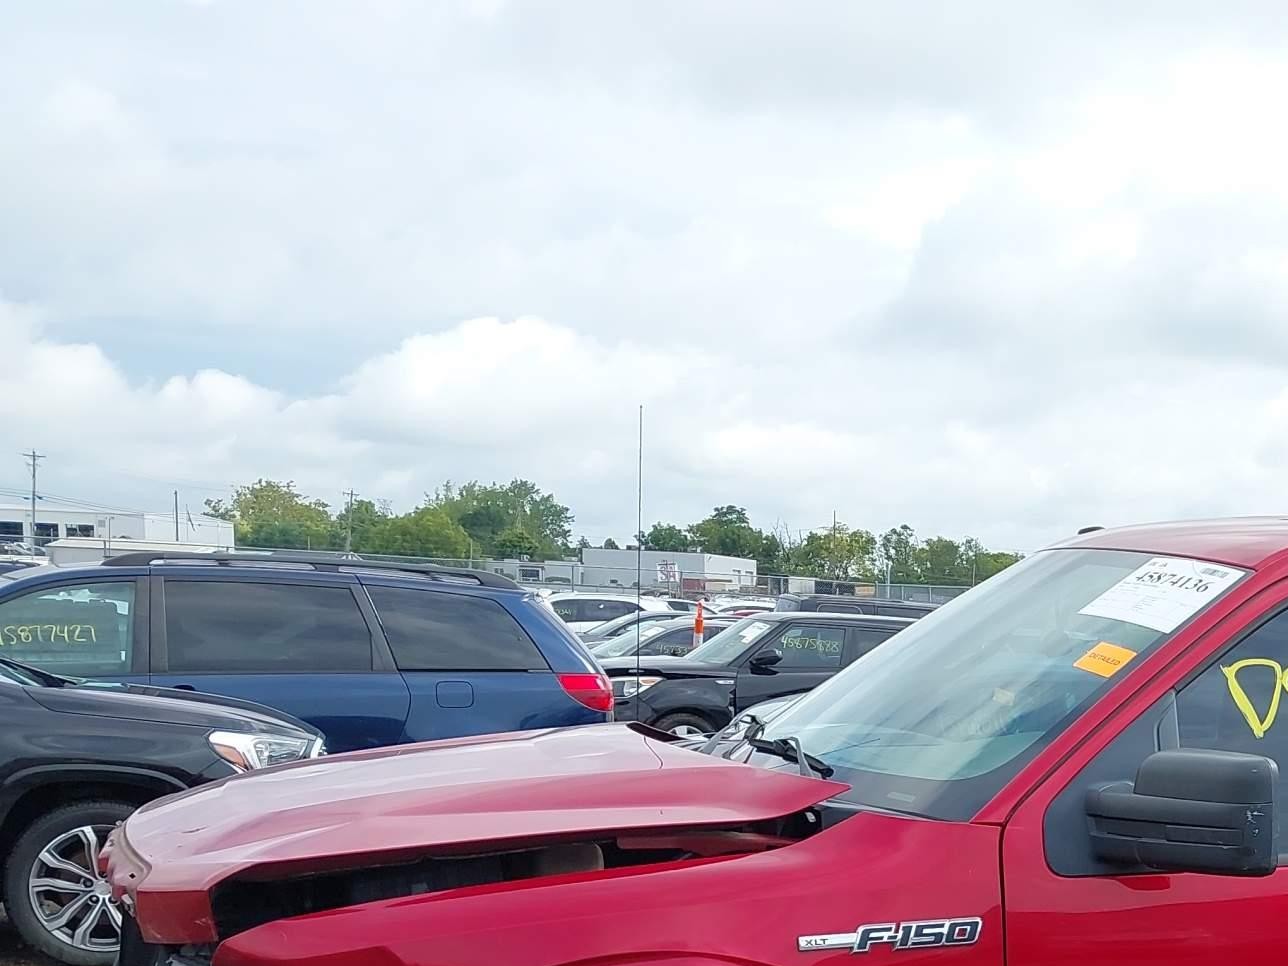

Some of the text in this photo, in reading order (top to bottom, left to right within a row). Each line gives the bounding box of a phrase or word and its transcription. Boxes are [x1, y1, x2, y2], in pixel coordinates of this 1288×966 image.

[1136, 570, 1216, 593] 45874136
[1089, 652, 1121, 666] DETAILED
[805, 917, 982, 952] XLT F-150
